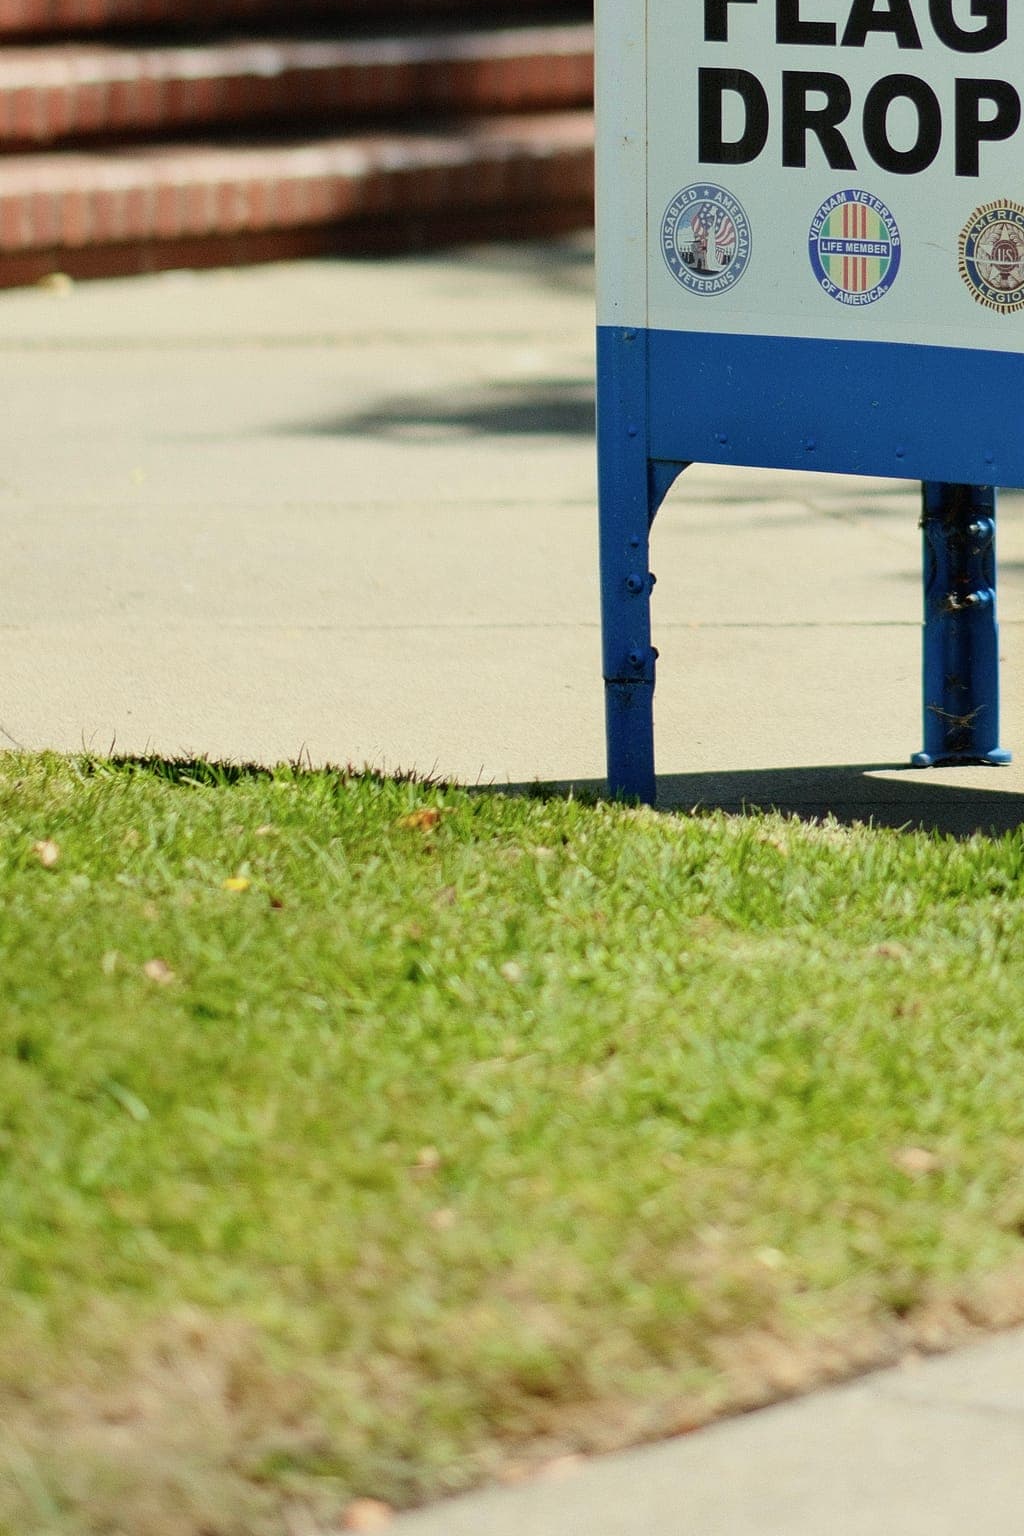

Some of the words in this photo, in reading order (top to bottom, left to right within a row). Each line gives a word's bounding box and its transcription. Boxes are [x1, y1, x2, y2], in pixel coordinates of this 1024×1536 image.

[698, 67, 1022, 177] DROP
[664, 190, 698, 249] DISABLED
[714, 191, 749, 259] AMERICAN
[809, 192, 847, 241] VIETNAM
[852, 190, 900, 247] VETERANS
[821, 241, 843, 252] LIFE
[845, 242, 888, 255] MEMBER
[678, 267, 735, 292] VETERANS
[821, 278, 837, 293] OF
